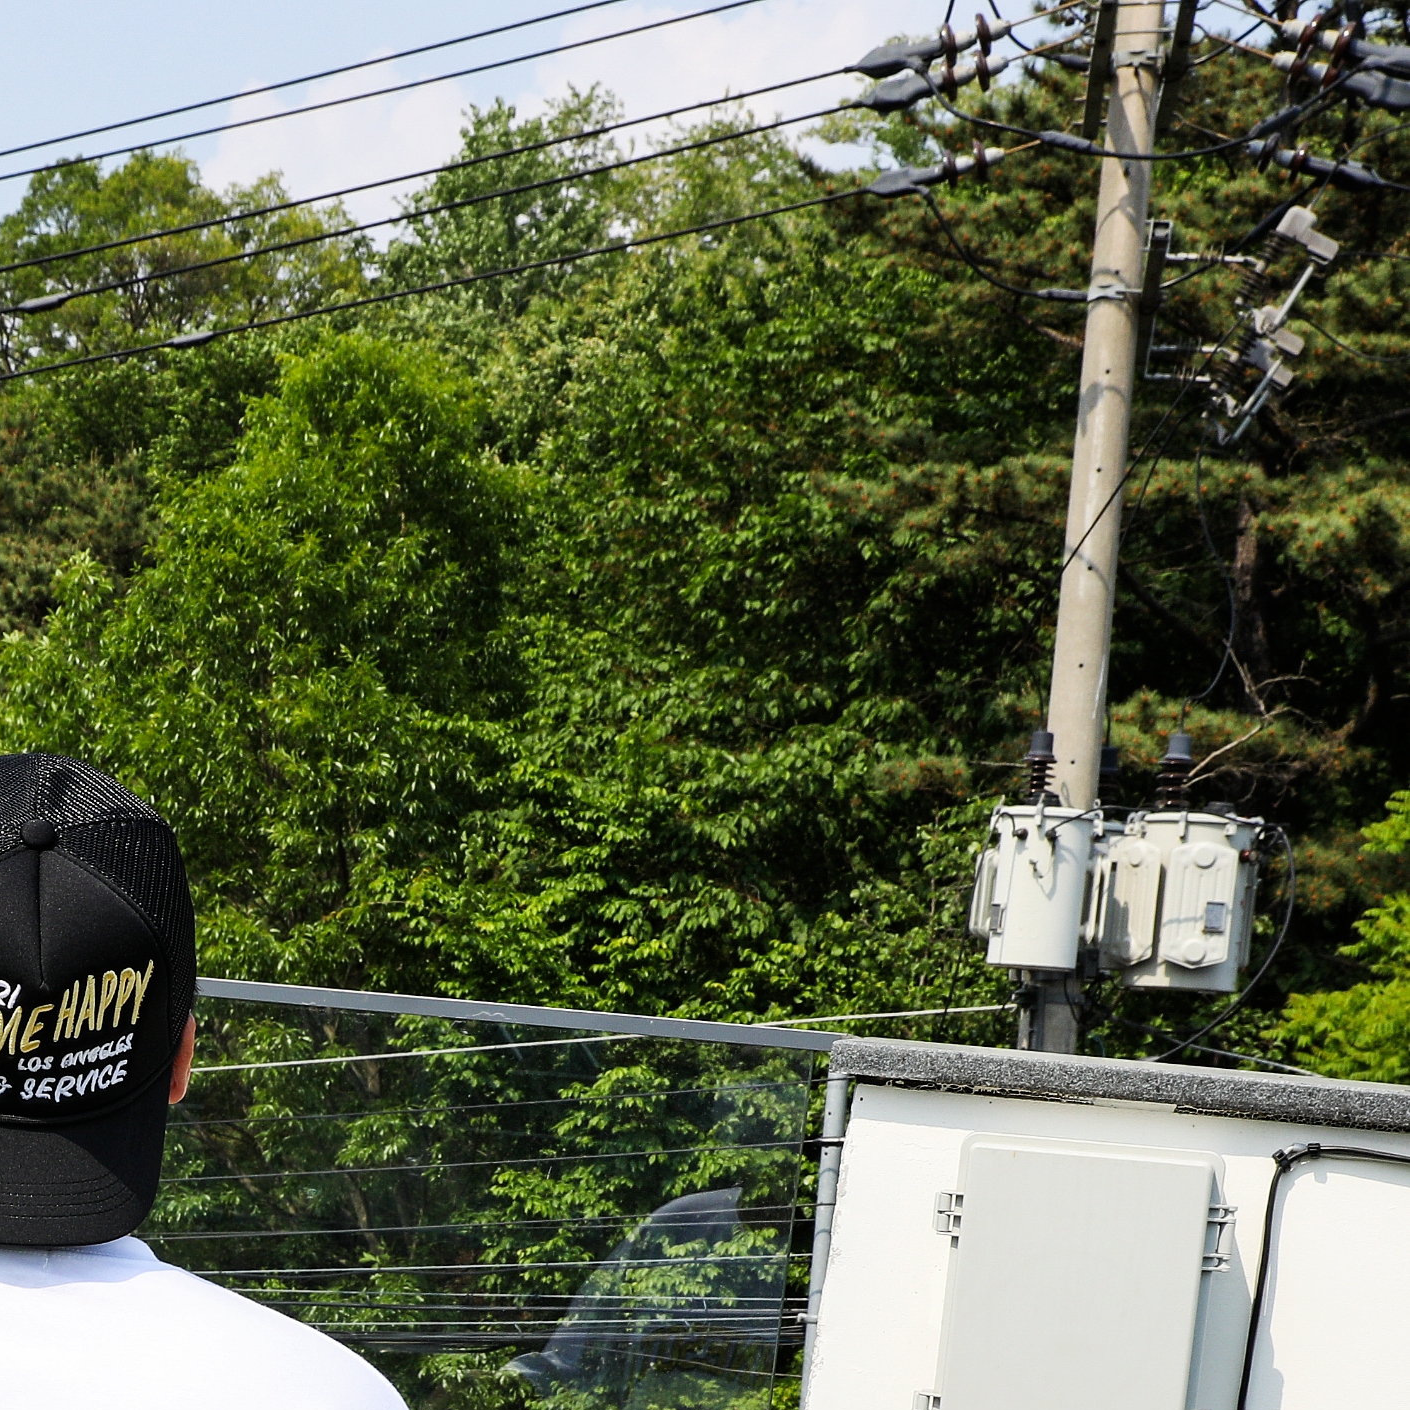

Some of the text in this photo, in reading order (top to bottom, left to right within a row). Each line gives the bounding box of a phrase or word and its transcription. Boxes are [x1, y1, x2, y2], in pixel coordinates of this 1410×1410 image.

[53, 959, 154, 1042] HAPPY
[18, 1033, 134, 1073] LOS ANGELES
[20, 1060, 128, 1102] SERVICE
